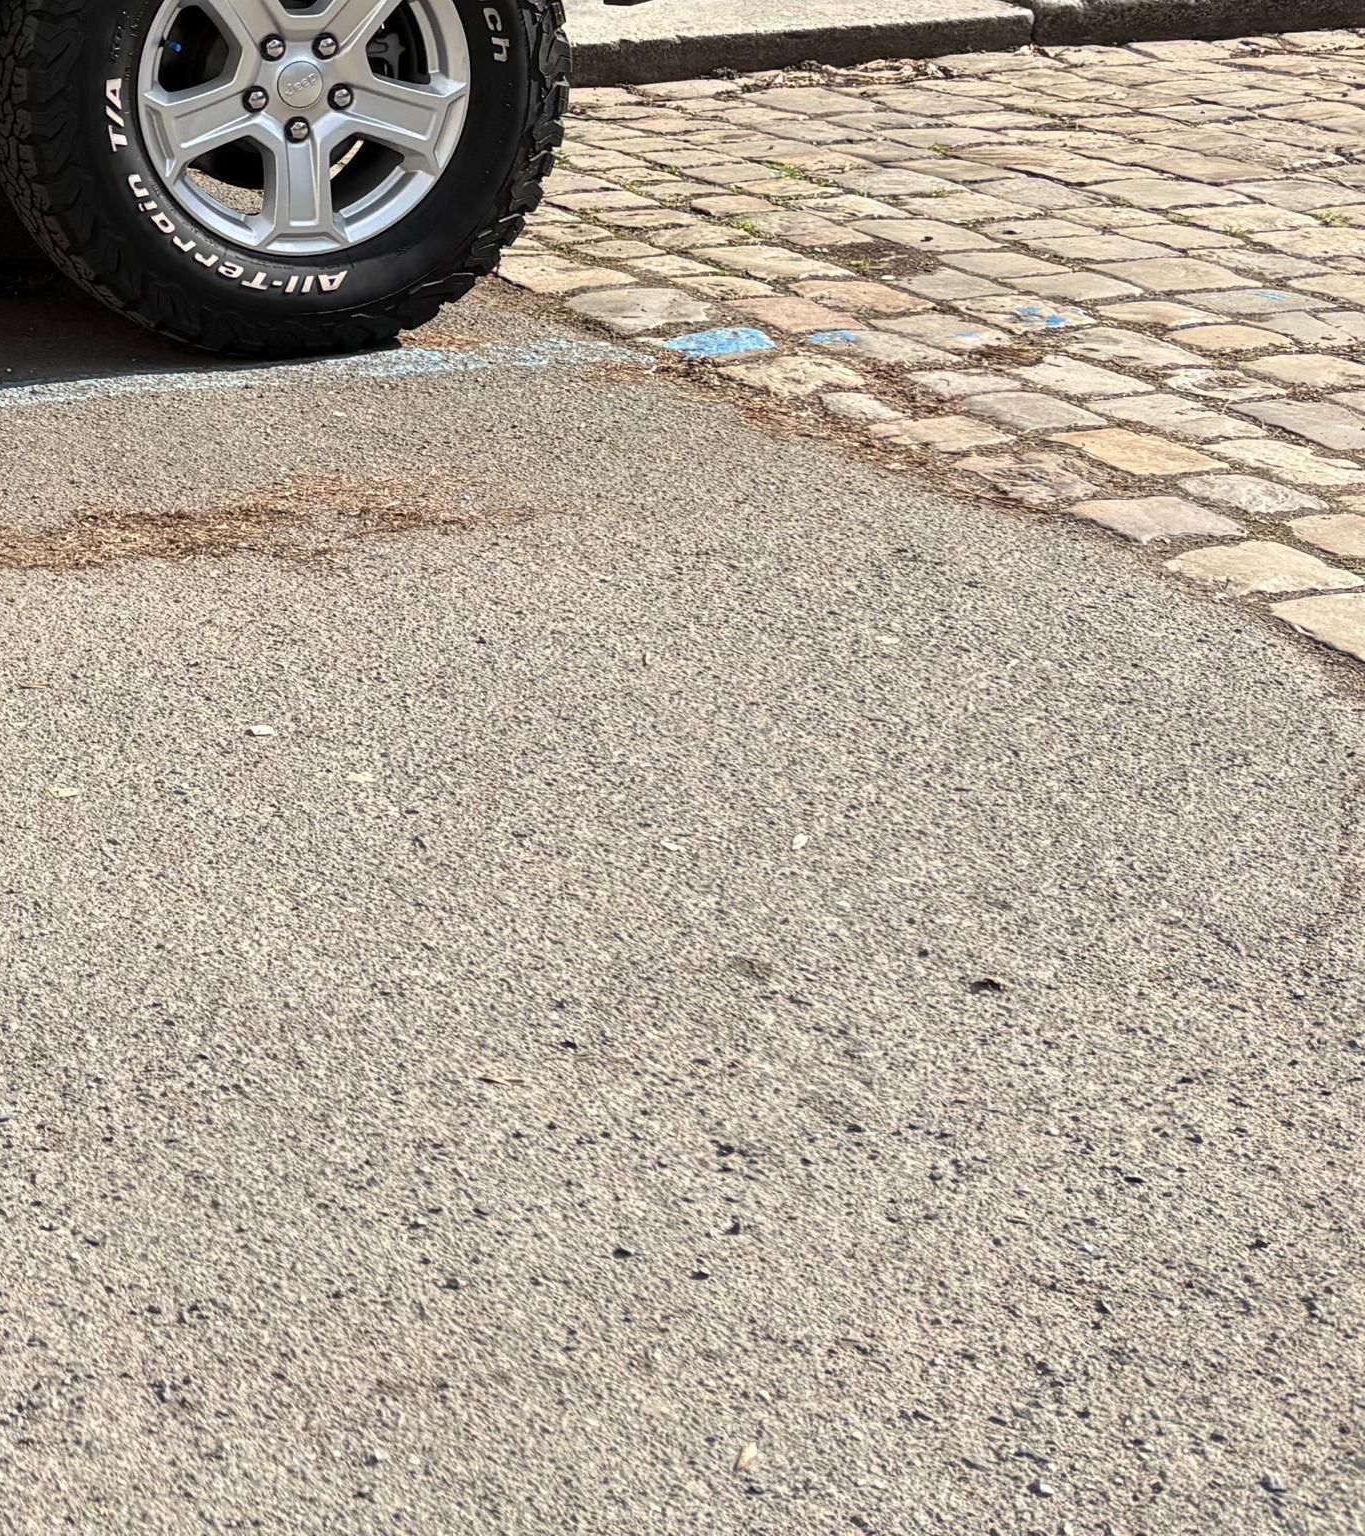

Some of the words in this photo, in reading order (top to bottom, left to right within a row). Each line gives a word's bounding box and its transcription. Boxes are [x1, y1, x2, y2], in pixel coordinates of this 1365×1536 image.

[105, 78, 129, 153] T/A
[284, 73, 317, 96] Jeep
[127, 174, 350, 295] All-Terrain
